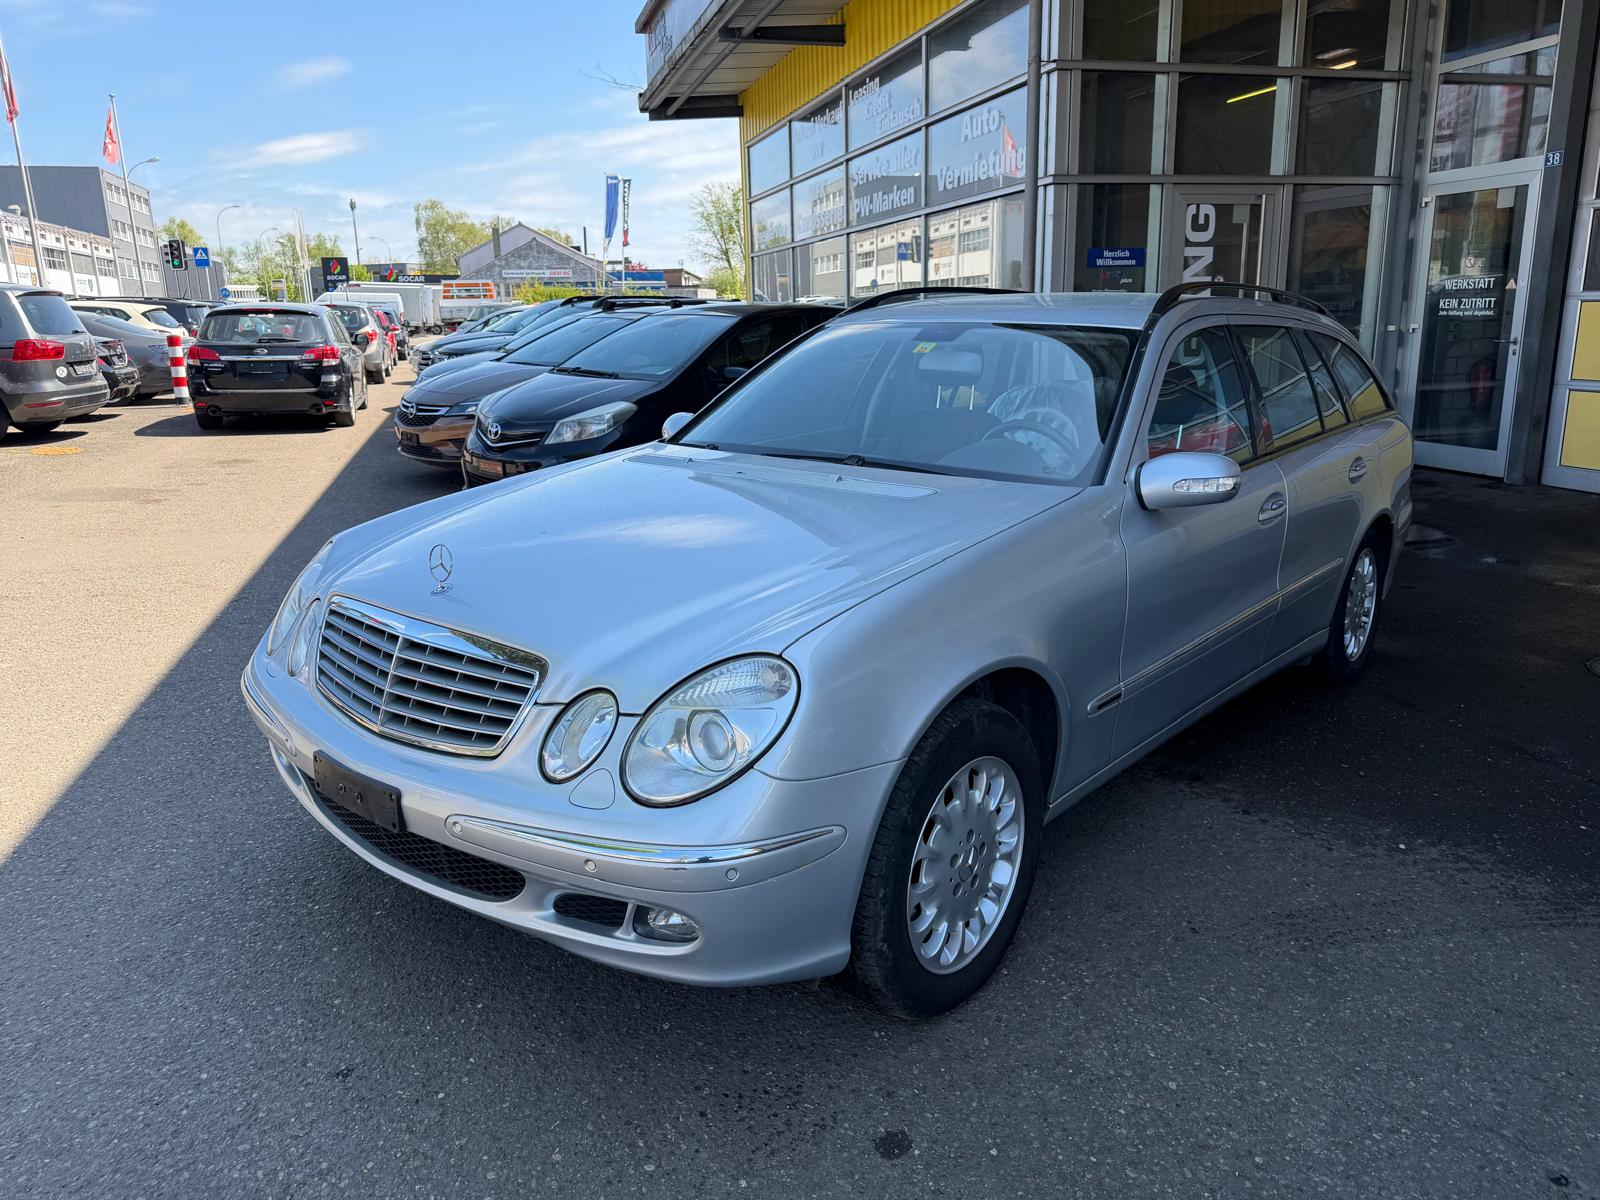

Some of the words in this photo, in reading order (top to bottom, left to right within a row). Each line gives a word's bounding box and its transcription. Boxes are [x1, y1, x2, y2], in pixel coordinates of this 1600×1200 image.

[849, 76, 880, 105] Leasing
[961, 107, 1000, 142] Auto
[1546, 152, 1560, 165] 38
[852, 155, 889, 188] Service
[936, 145, 1026, 192] Vermietung
[854, 184, 914, 218] PW-Marken
[1103, 249, 1130, 258] Herzlich
[1096, 258, 1136, 267] Willkommen
[398, 275, 425, 283] SOCAR
[1445, 277, 1496, 290] WERKSTATT
[1439, 298, 1459, 309] KEIN
[1460, 297, 1497, 309] ZUTRITT
